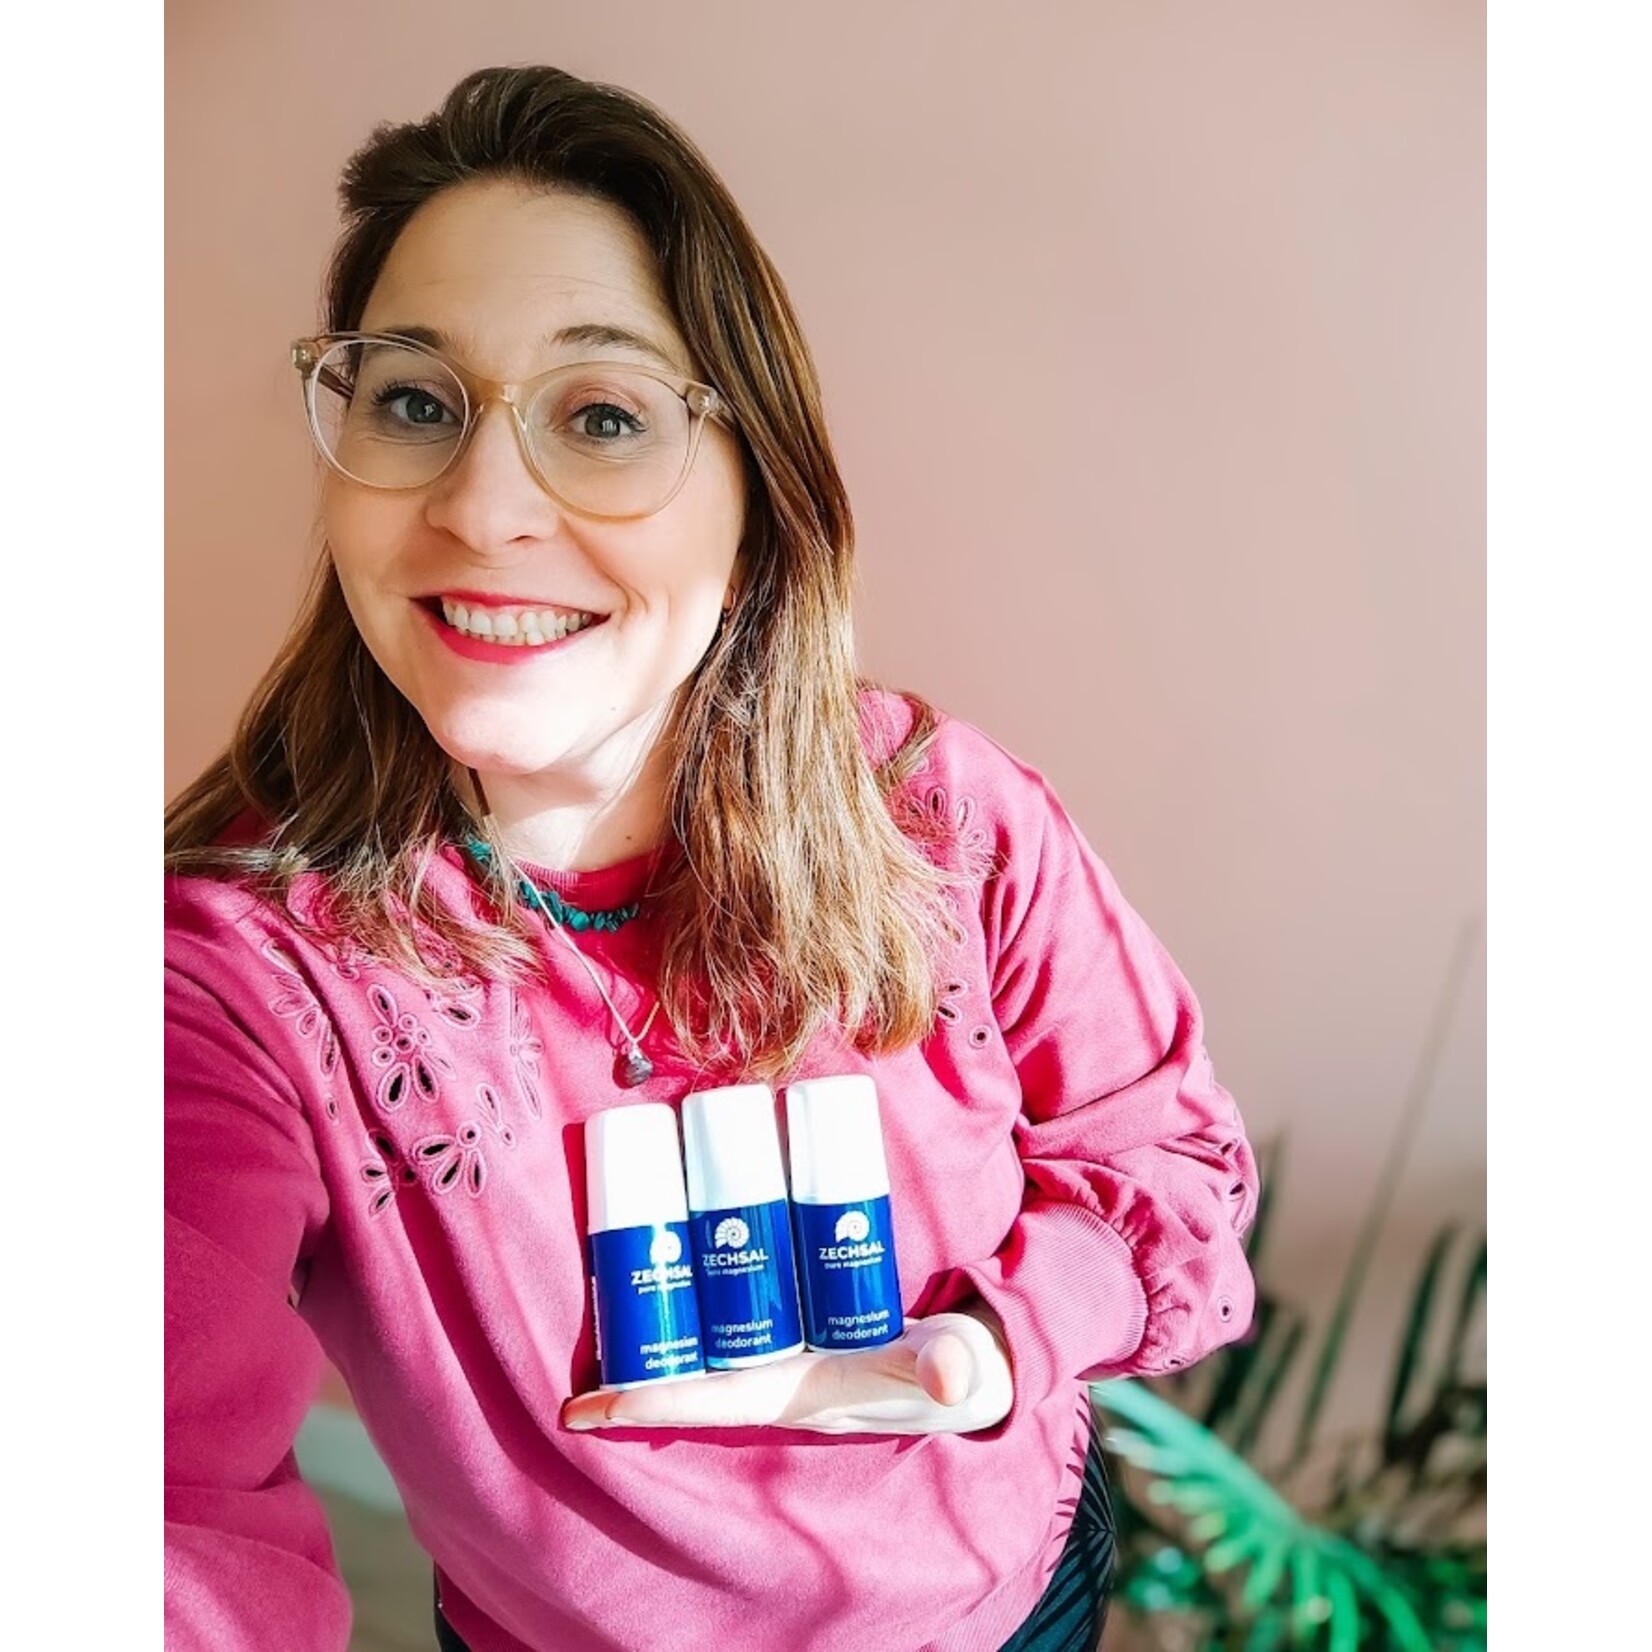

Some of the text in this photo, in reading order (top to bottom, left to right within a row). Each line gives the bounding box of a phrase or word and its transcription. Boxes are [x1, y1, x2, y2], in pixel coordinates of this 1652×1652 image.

[702, 1248, 769, 1266] ZECHSAL
[819, 1240, 885, 1260] ZECHSAL
[631, 1264, 693, 1286] ZECHSAL
[828, 1309, 890, 1327] magnesium
[711, 1319, 773, 1336] magnesium
[832, 1324, 888, 1340] deodorant
[715, 1333, 772, 1349] deodorant
